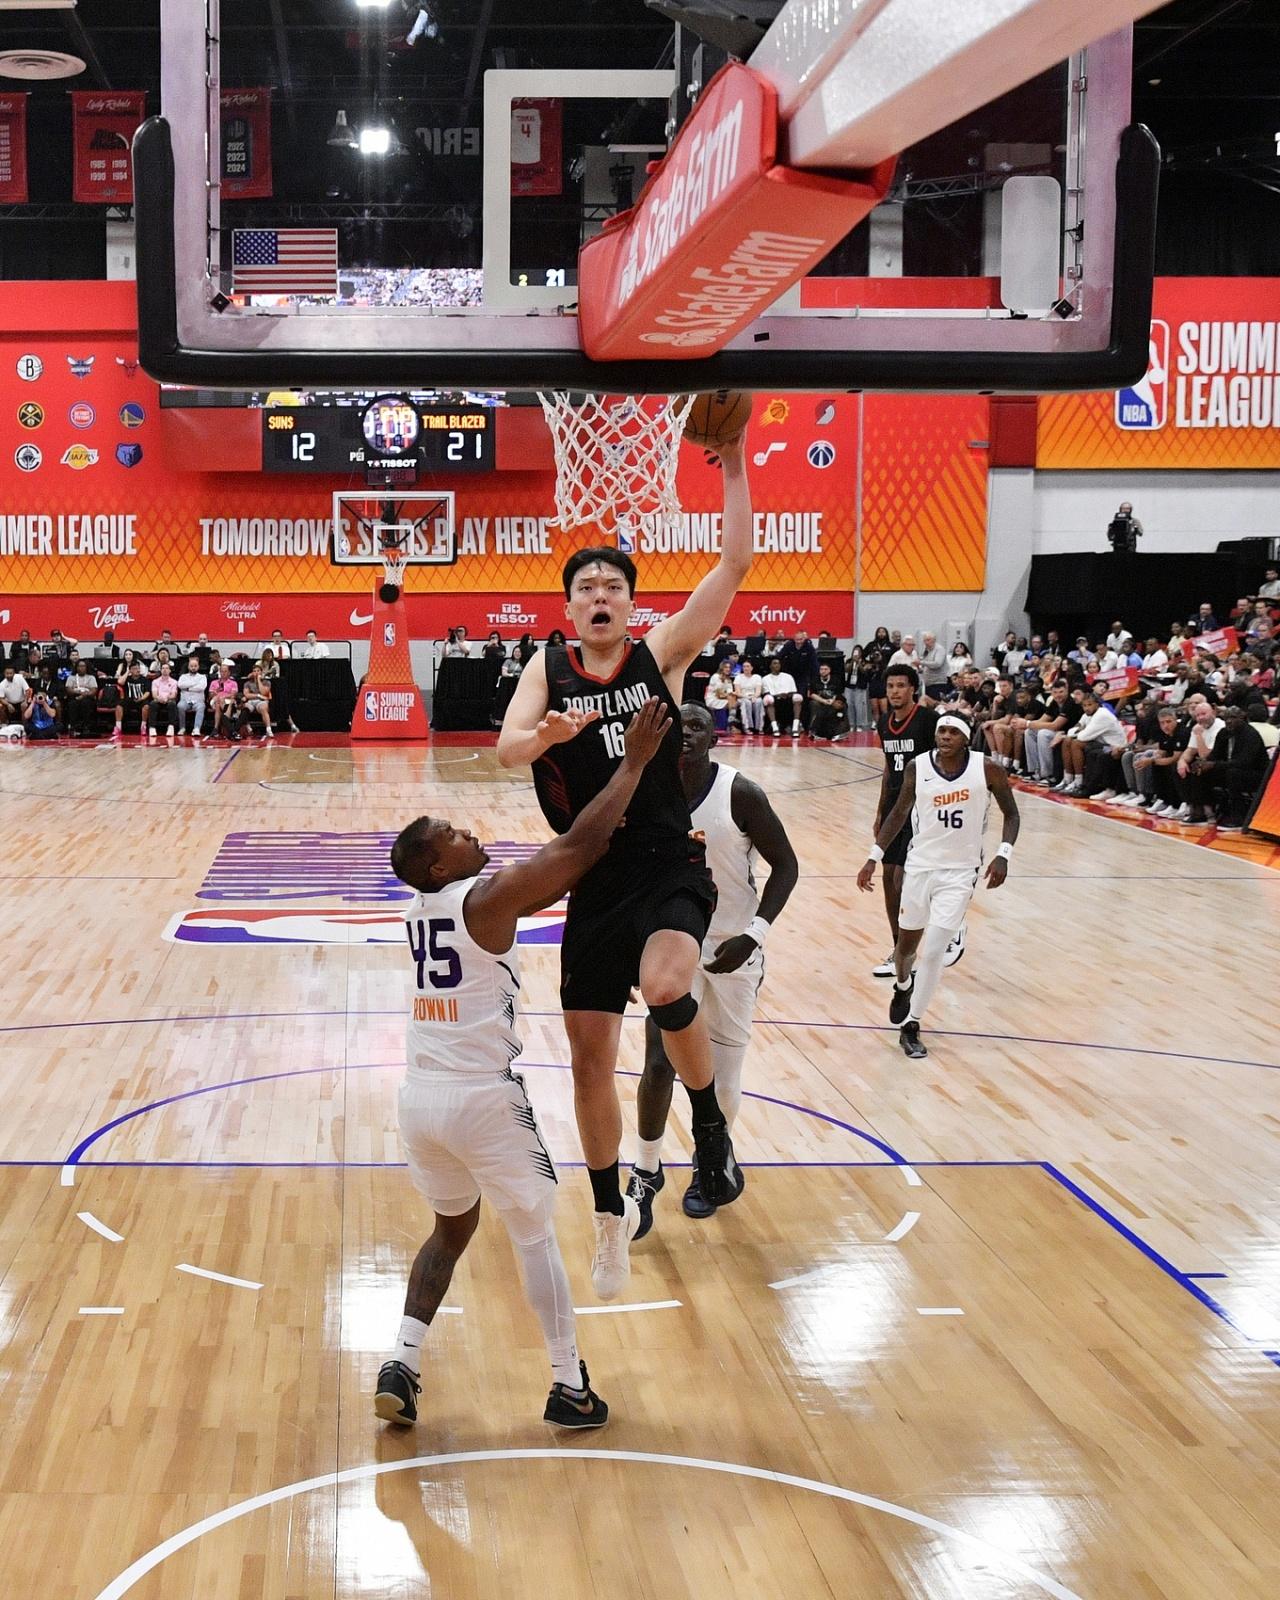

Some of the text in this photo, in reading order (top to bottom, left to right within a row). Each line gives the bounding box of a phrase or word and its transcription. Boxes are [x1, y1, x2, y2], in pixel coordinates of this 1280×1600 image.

[521, 124, 531, 138] 4
[226, 152, 246, 162] 2023
[546, 268, 565, 286] 21
[1177, 321, 1280, 374] SUMM
[268, 415, 293, 429] SUNS
[422, 415, 486, 429] TRAIL BLAZER
[1122, 404, 1148, 422] NBA
[292, 432, 315, 461] 12
[447, 432, 482, 460] 21
[381, 459, 417, 467] TISSOT
[58, 515, 137, 555] LEAGUE
[495, 517, 553, 554] HERE
[752, 512, 823, 553] EAGUE
[88, 605, 134, 630] Vegas
[226, 612, 257, 620] ULTRA
[486, 613, 538, 624] TISSOT
[750, 605, 806, 624] xfinity
[380, 692, 414, 707] SUMMER
[380, 706, 409, 721] LEAGUE
[599, 721, 626, 759] 16
[894, 754, 904, 771] 26
[937, 809, 963, 829] 46
[406, 917, 463, 989] 45
